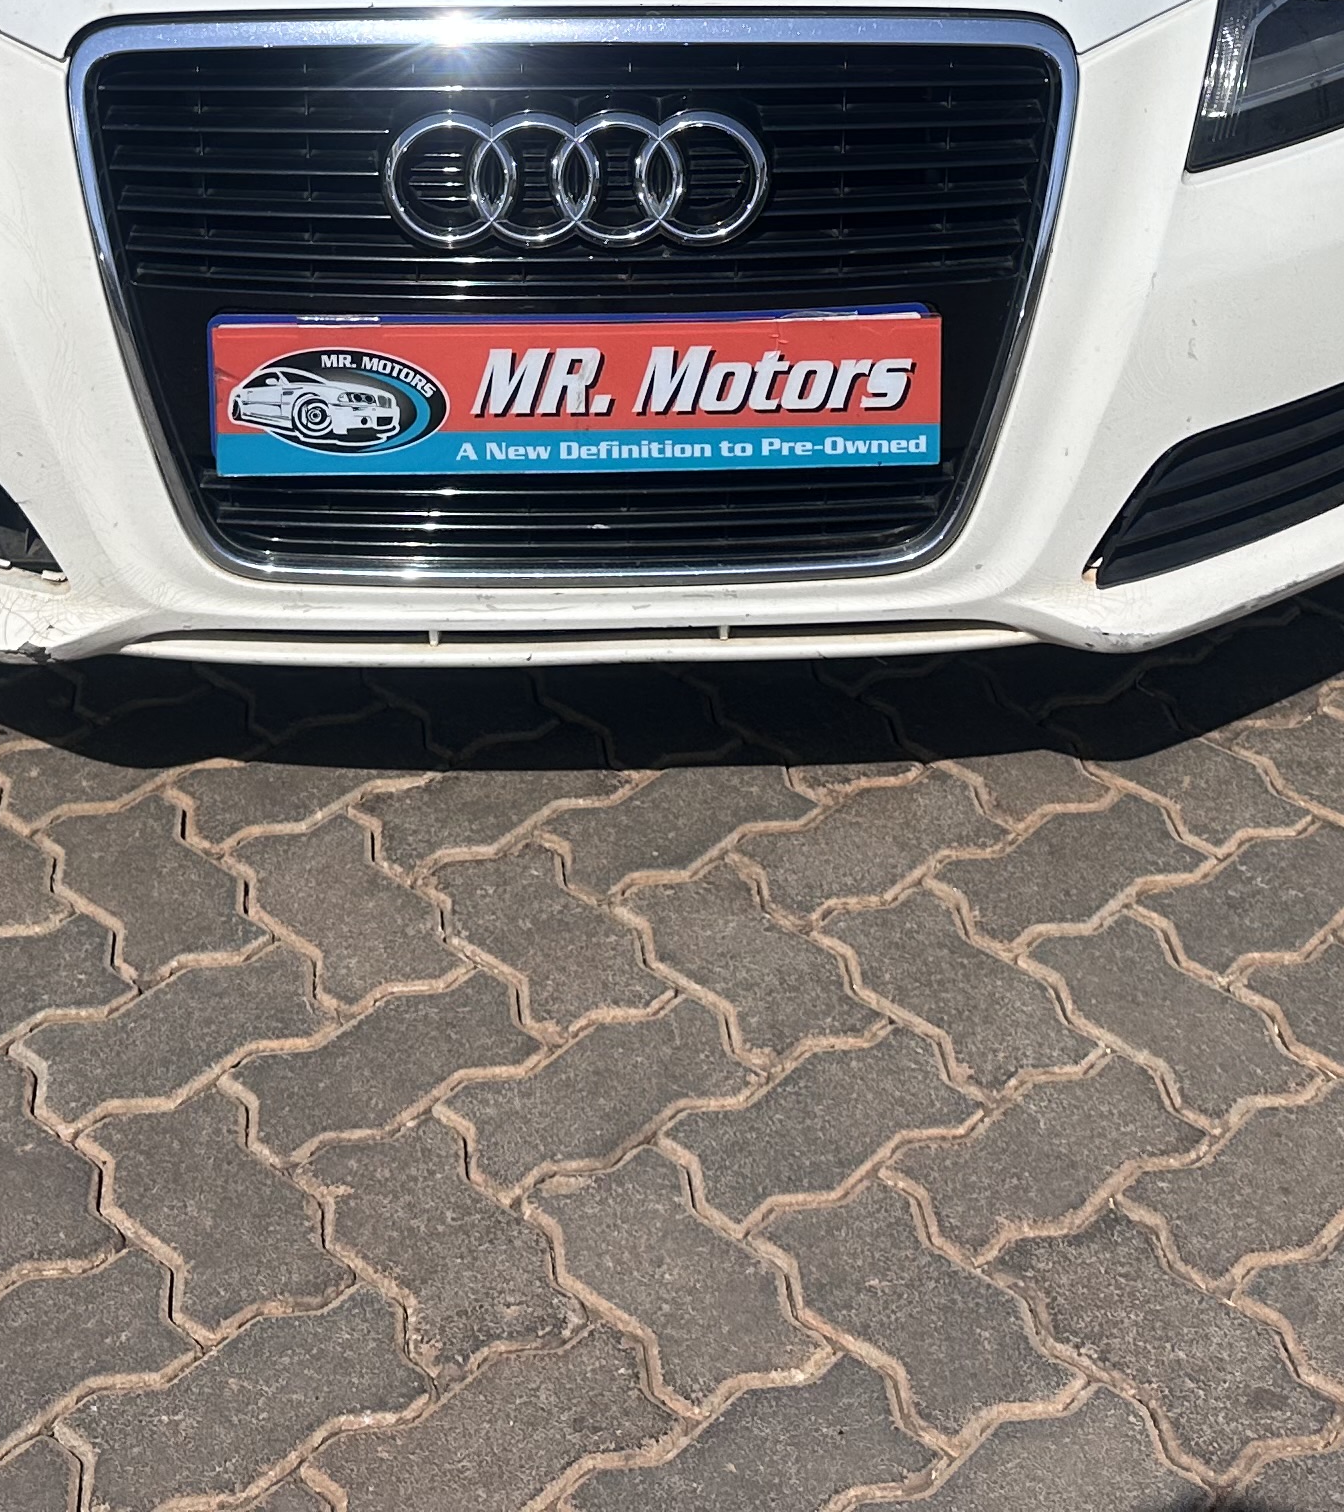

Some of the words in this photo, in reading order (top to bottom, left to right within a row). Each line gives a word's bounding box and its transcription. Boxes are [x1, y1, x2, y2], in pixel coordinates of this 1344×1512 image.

[321, 354, 356, 368] MR.
[361, 356, 436, 398] MOTORS
[470, 347, 615, 418] MR.
[631, 345, 916, 416] Motors
[456, 442, 478, 461] A
[486, 441, 551, 460] New
[559, 439, 712, 459] Definition
[719, 440, 753, 457] to
[761, 434, 927, 456] Pre-Owned
